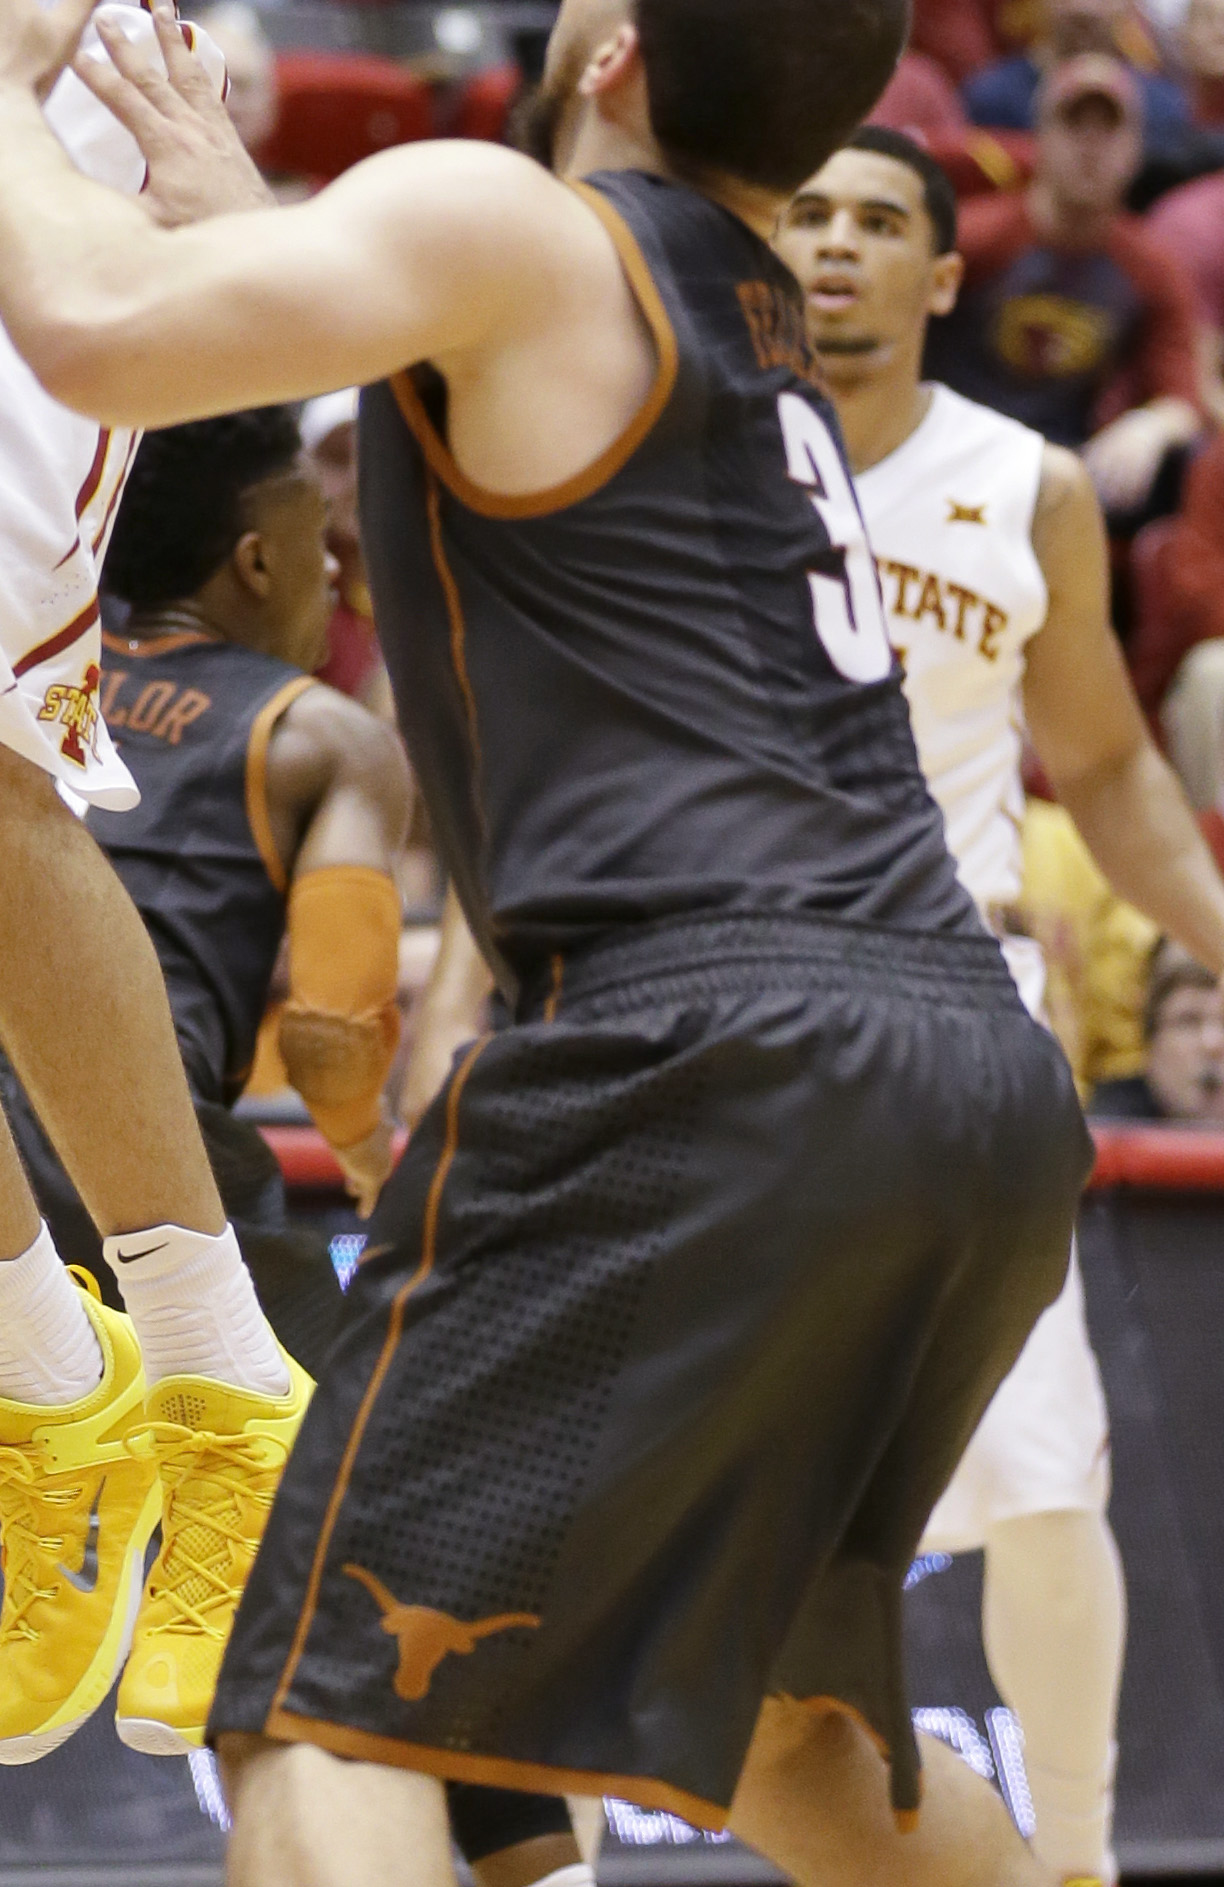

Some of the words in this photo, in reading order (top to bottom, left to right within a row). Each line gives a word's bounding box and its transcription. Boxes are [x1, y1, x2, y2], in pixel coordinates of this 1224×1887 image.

[777, 390, 892, 684] 3
[877, 554, 1008, 662] TATE
[99, 669, 212, 746] LOR
